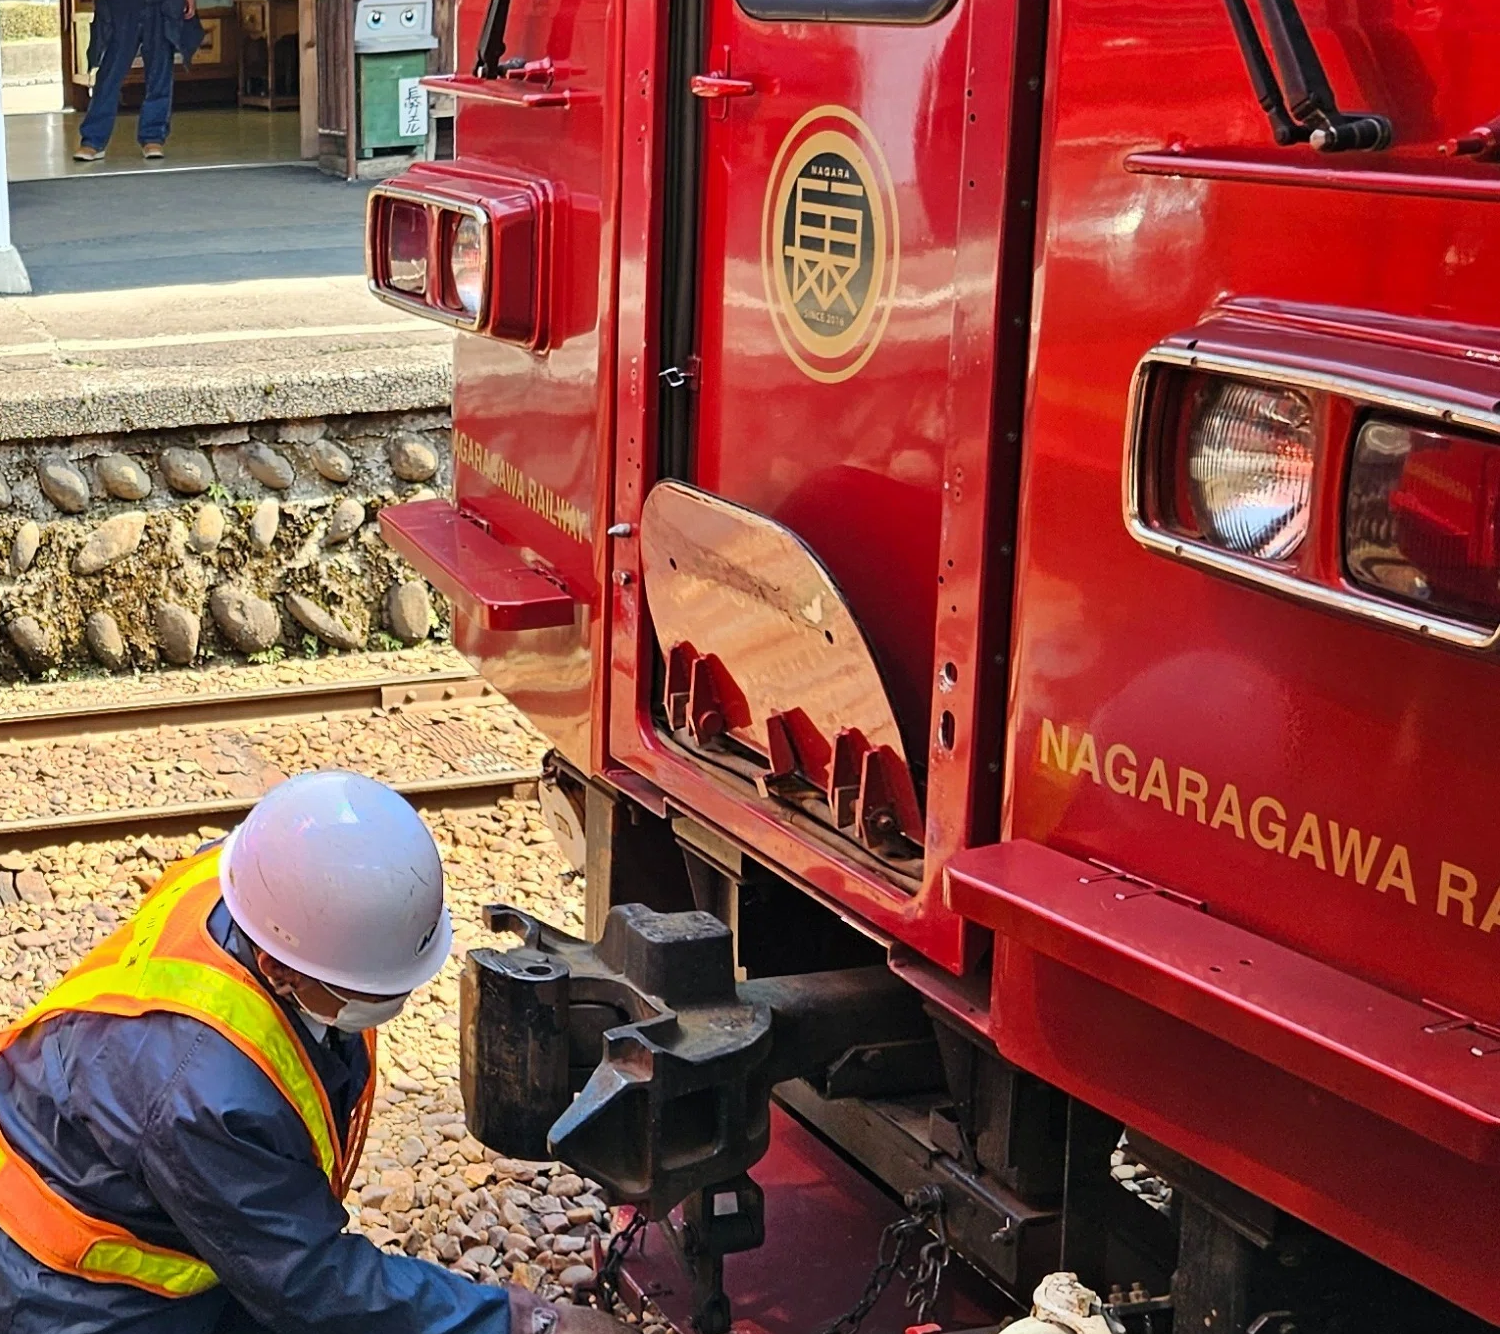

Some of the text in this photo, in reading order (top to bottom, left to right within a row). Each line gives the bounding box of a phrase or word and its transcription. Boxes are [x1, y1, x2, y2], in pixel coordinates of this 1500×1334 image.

[811, 165, 851, 180] NAGARA
[453, 427, 525, 505] AGARAGAWA
[1040, 717, 1417, 906] NAGARAGAWA
